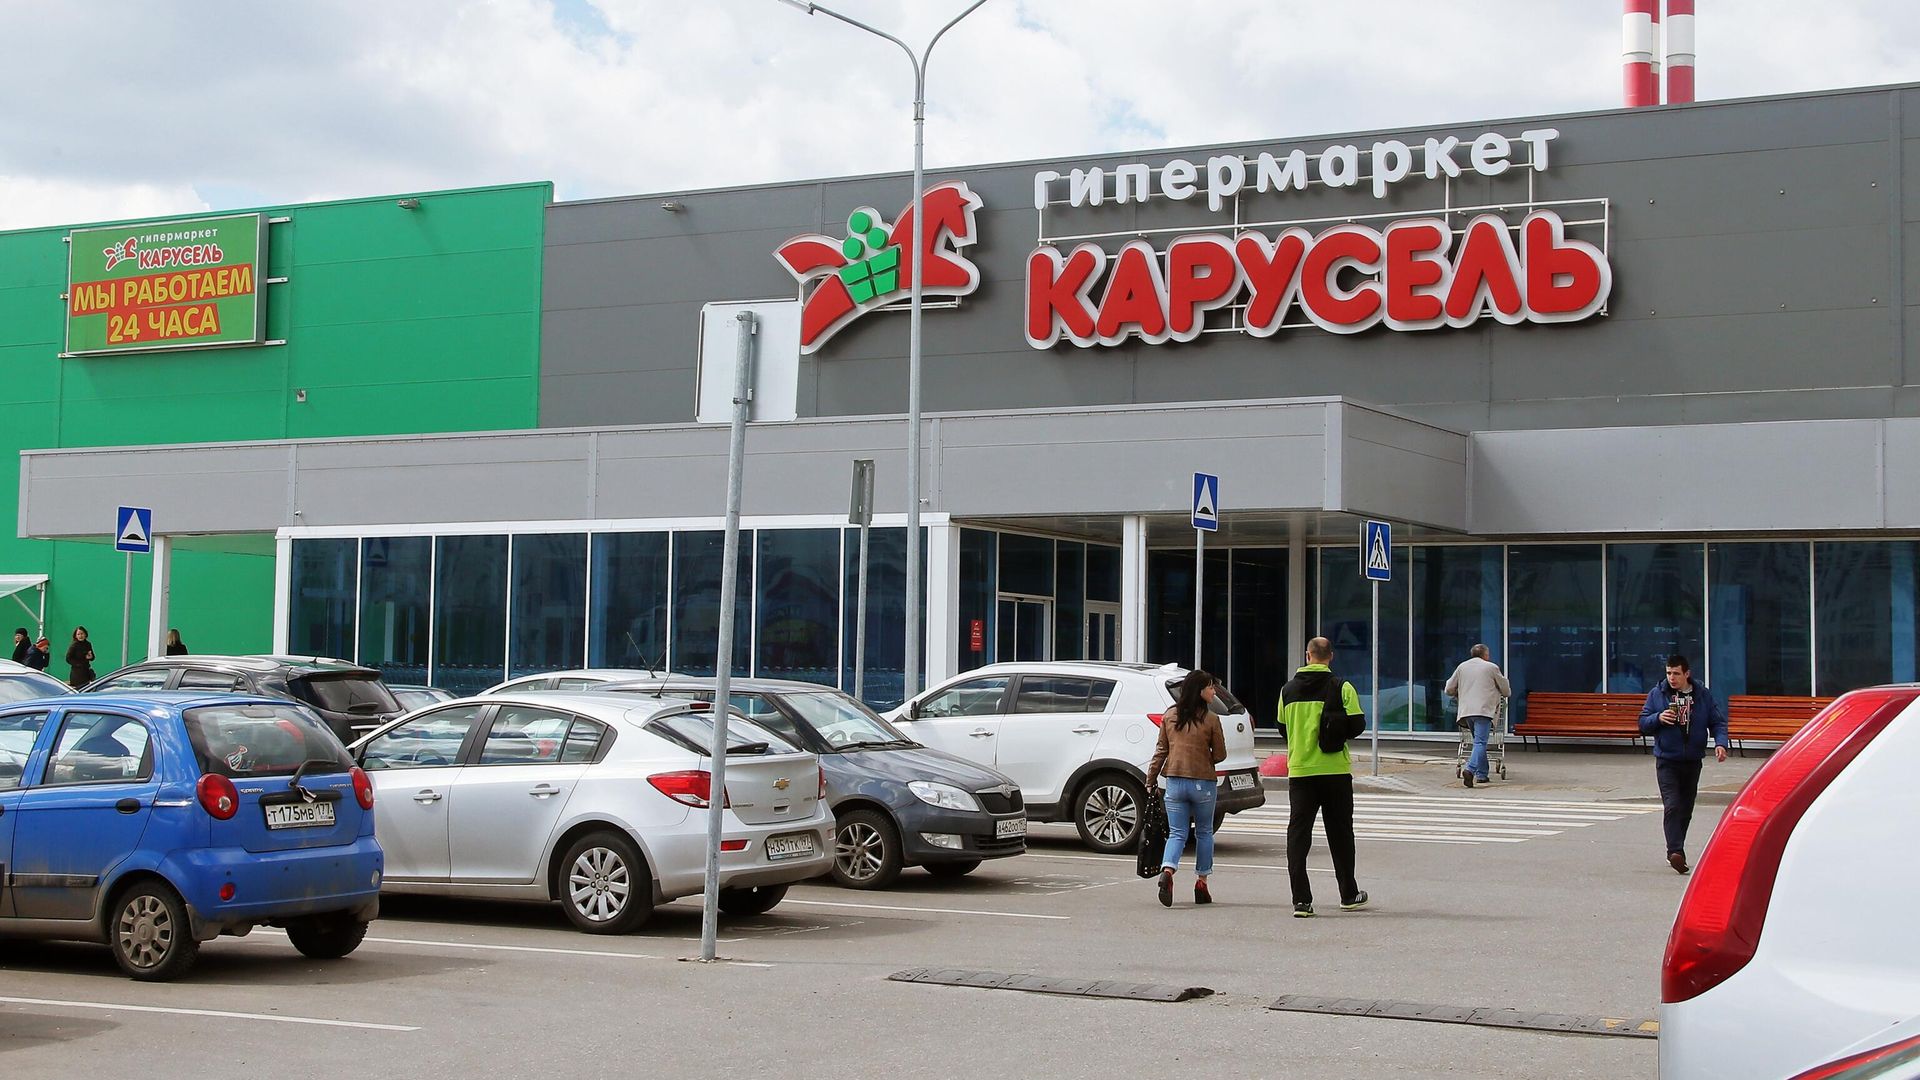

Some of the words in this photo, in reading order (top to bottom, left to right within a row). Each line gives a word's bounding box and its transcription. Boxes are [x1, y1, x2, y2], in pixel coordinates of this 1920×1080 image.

[1033, 128, 1560, 213] гипермаркет
[140, 228, 218, 244] гипермаркет
[138, 244, 223, 270] КАРУСЕЛЬ
[73, 283, 116, 312] МЫ
[124, 267, 252, 306] РАБОТАЕМ
[1025, 209, 1612, 351] КАРУСЕЛЬ
[109, 313, 140, 343] 24
[148, 306, 218, 338] ЧАСА
